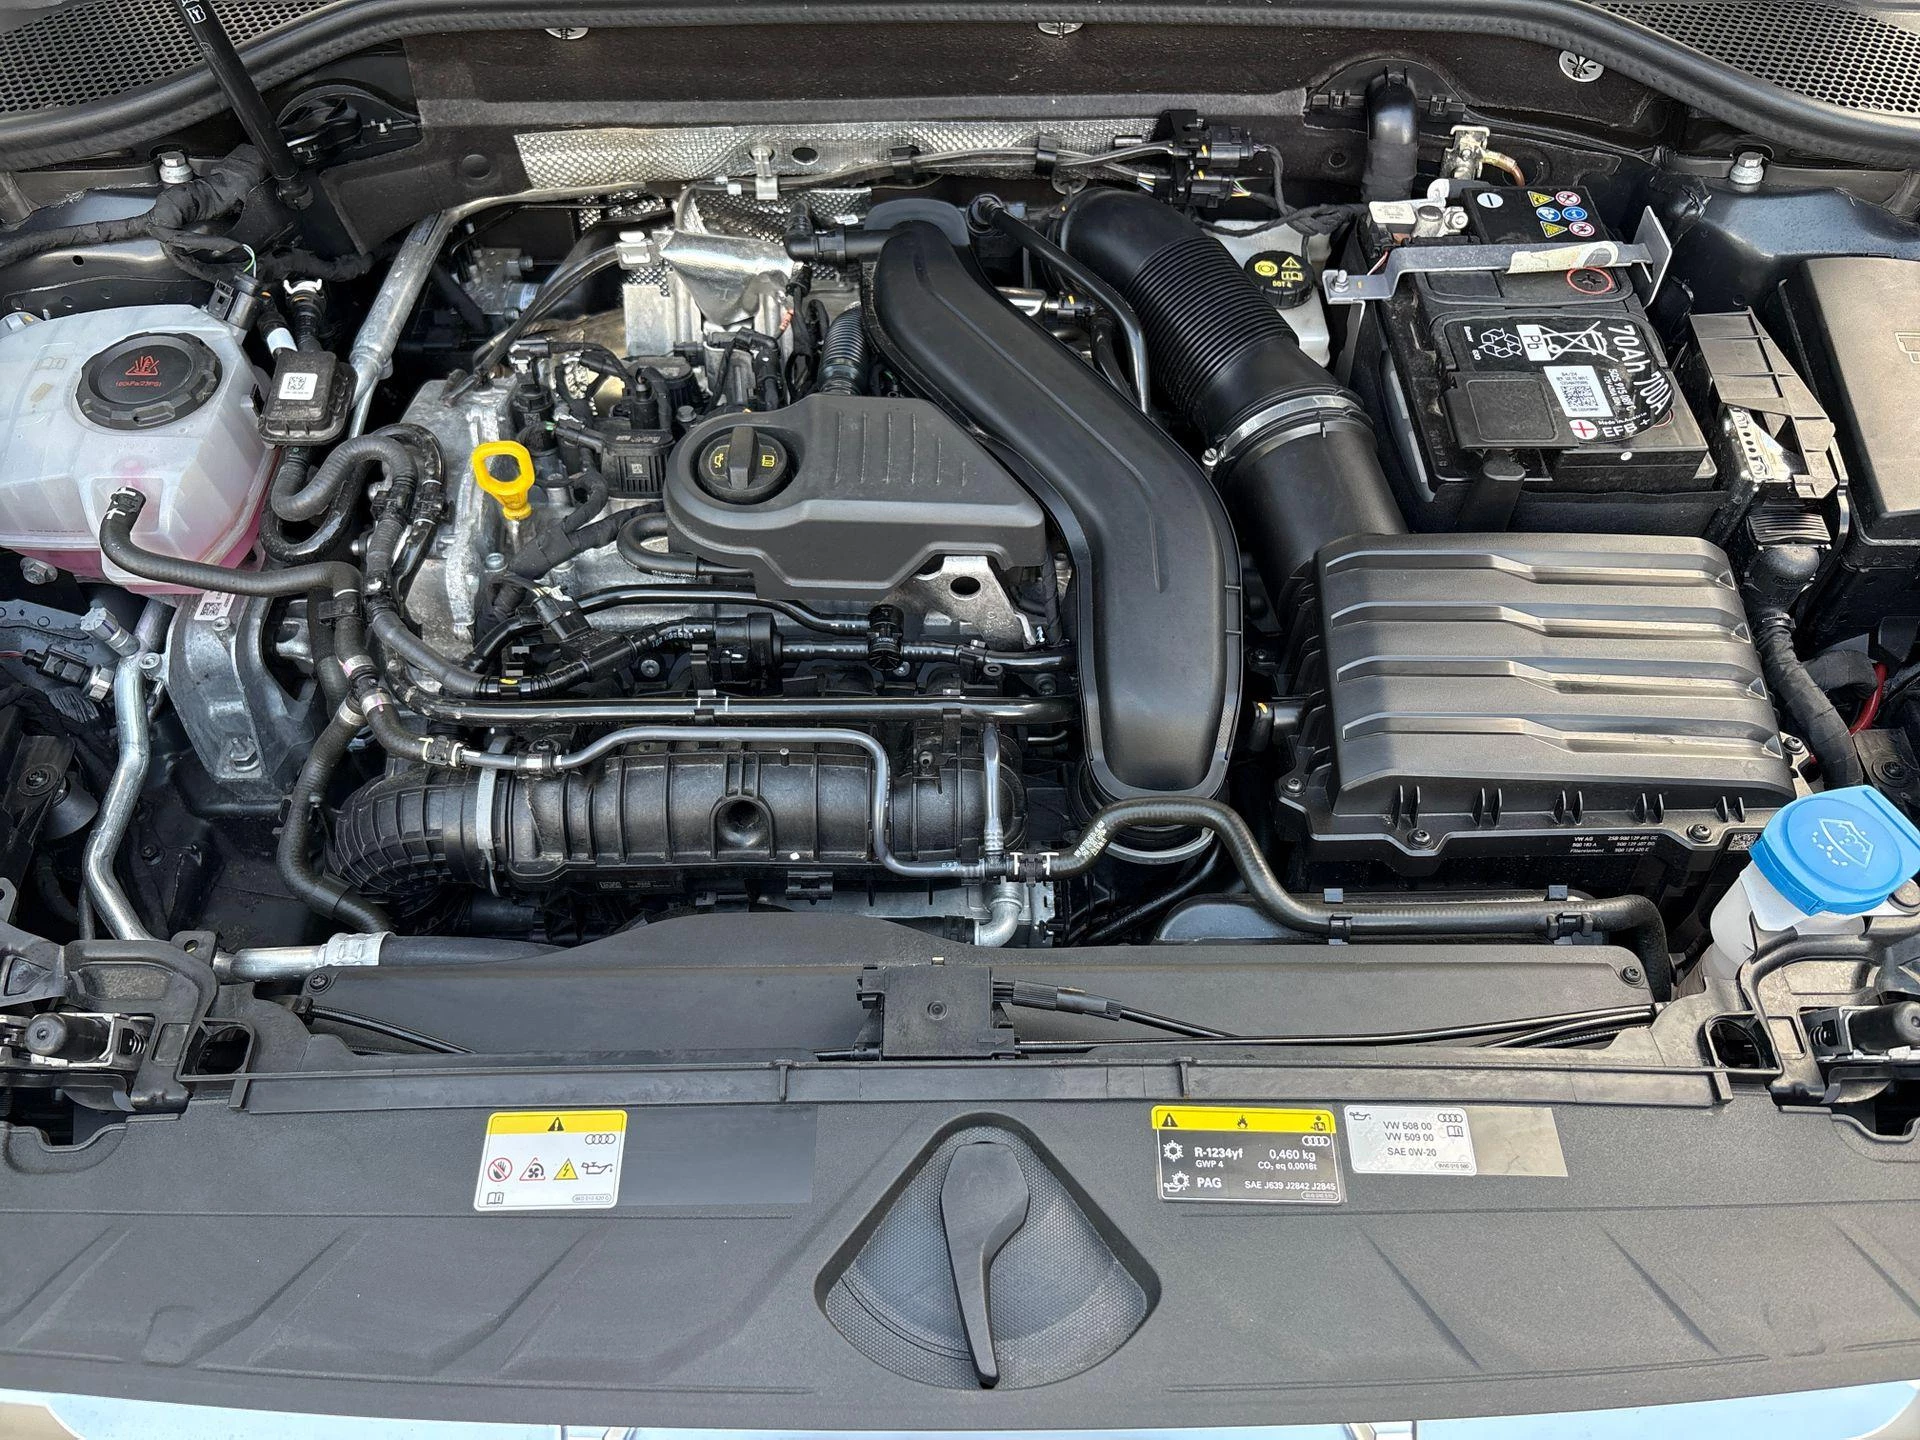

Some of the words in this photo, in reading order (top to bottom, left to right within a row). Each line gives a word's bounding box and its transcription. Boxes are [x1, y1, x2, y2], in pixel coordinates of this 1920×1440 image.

[1523, 335, 1541, 350] Pb
[1607, 325, 1652, 373] 70Ah
[1634, 371, 1673, 415] 700A
[1602, 422, 1638, 438] EFB
[1383, 1121, 1400, 1130] VW
[1402, 1121, 1419, 1130] 508
[1420, 1122, 1432, 1131] 00
[1385, 1132, 1402, 1141] VW
[1404, 1133, 1421, 1141] 509
[1423, 1133, 1434, 1142] 00
[1194, 1147, 1244, 1160] R-1234yf
[1269, 1149, 1299, 1161] 0,460
[1302, 1150, 1316, 1162] kg
[1387, 1147, 1407, 1156] SAE
[1408, 1147, 1437, 1157] 0W-20
[1195, 1159, 1217, 1168] GWP
[1218, 1160, 1224, 1168] 4
[1275, 1162, 1287, 1171] eq
[1197, 1177, 1222, 1188] PAG
[1244, 1181, 1262, 1190] SAE
[1264, 1181, 1284, 1190] J639
[1285, 1181, 1310, 1191] J2842
[1311, 1182, 1336, 1191] J2845
